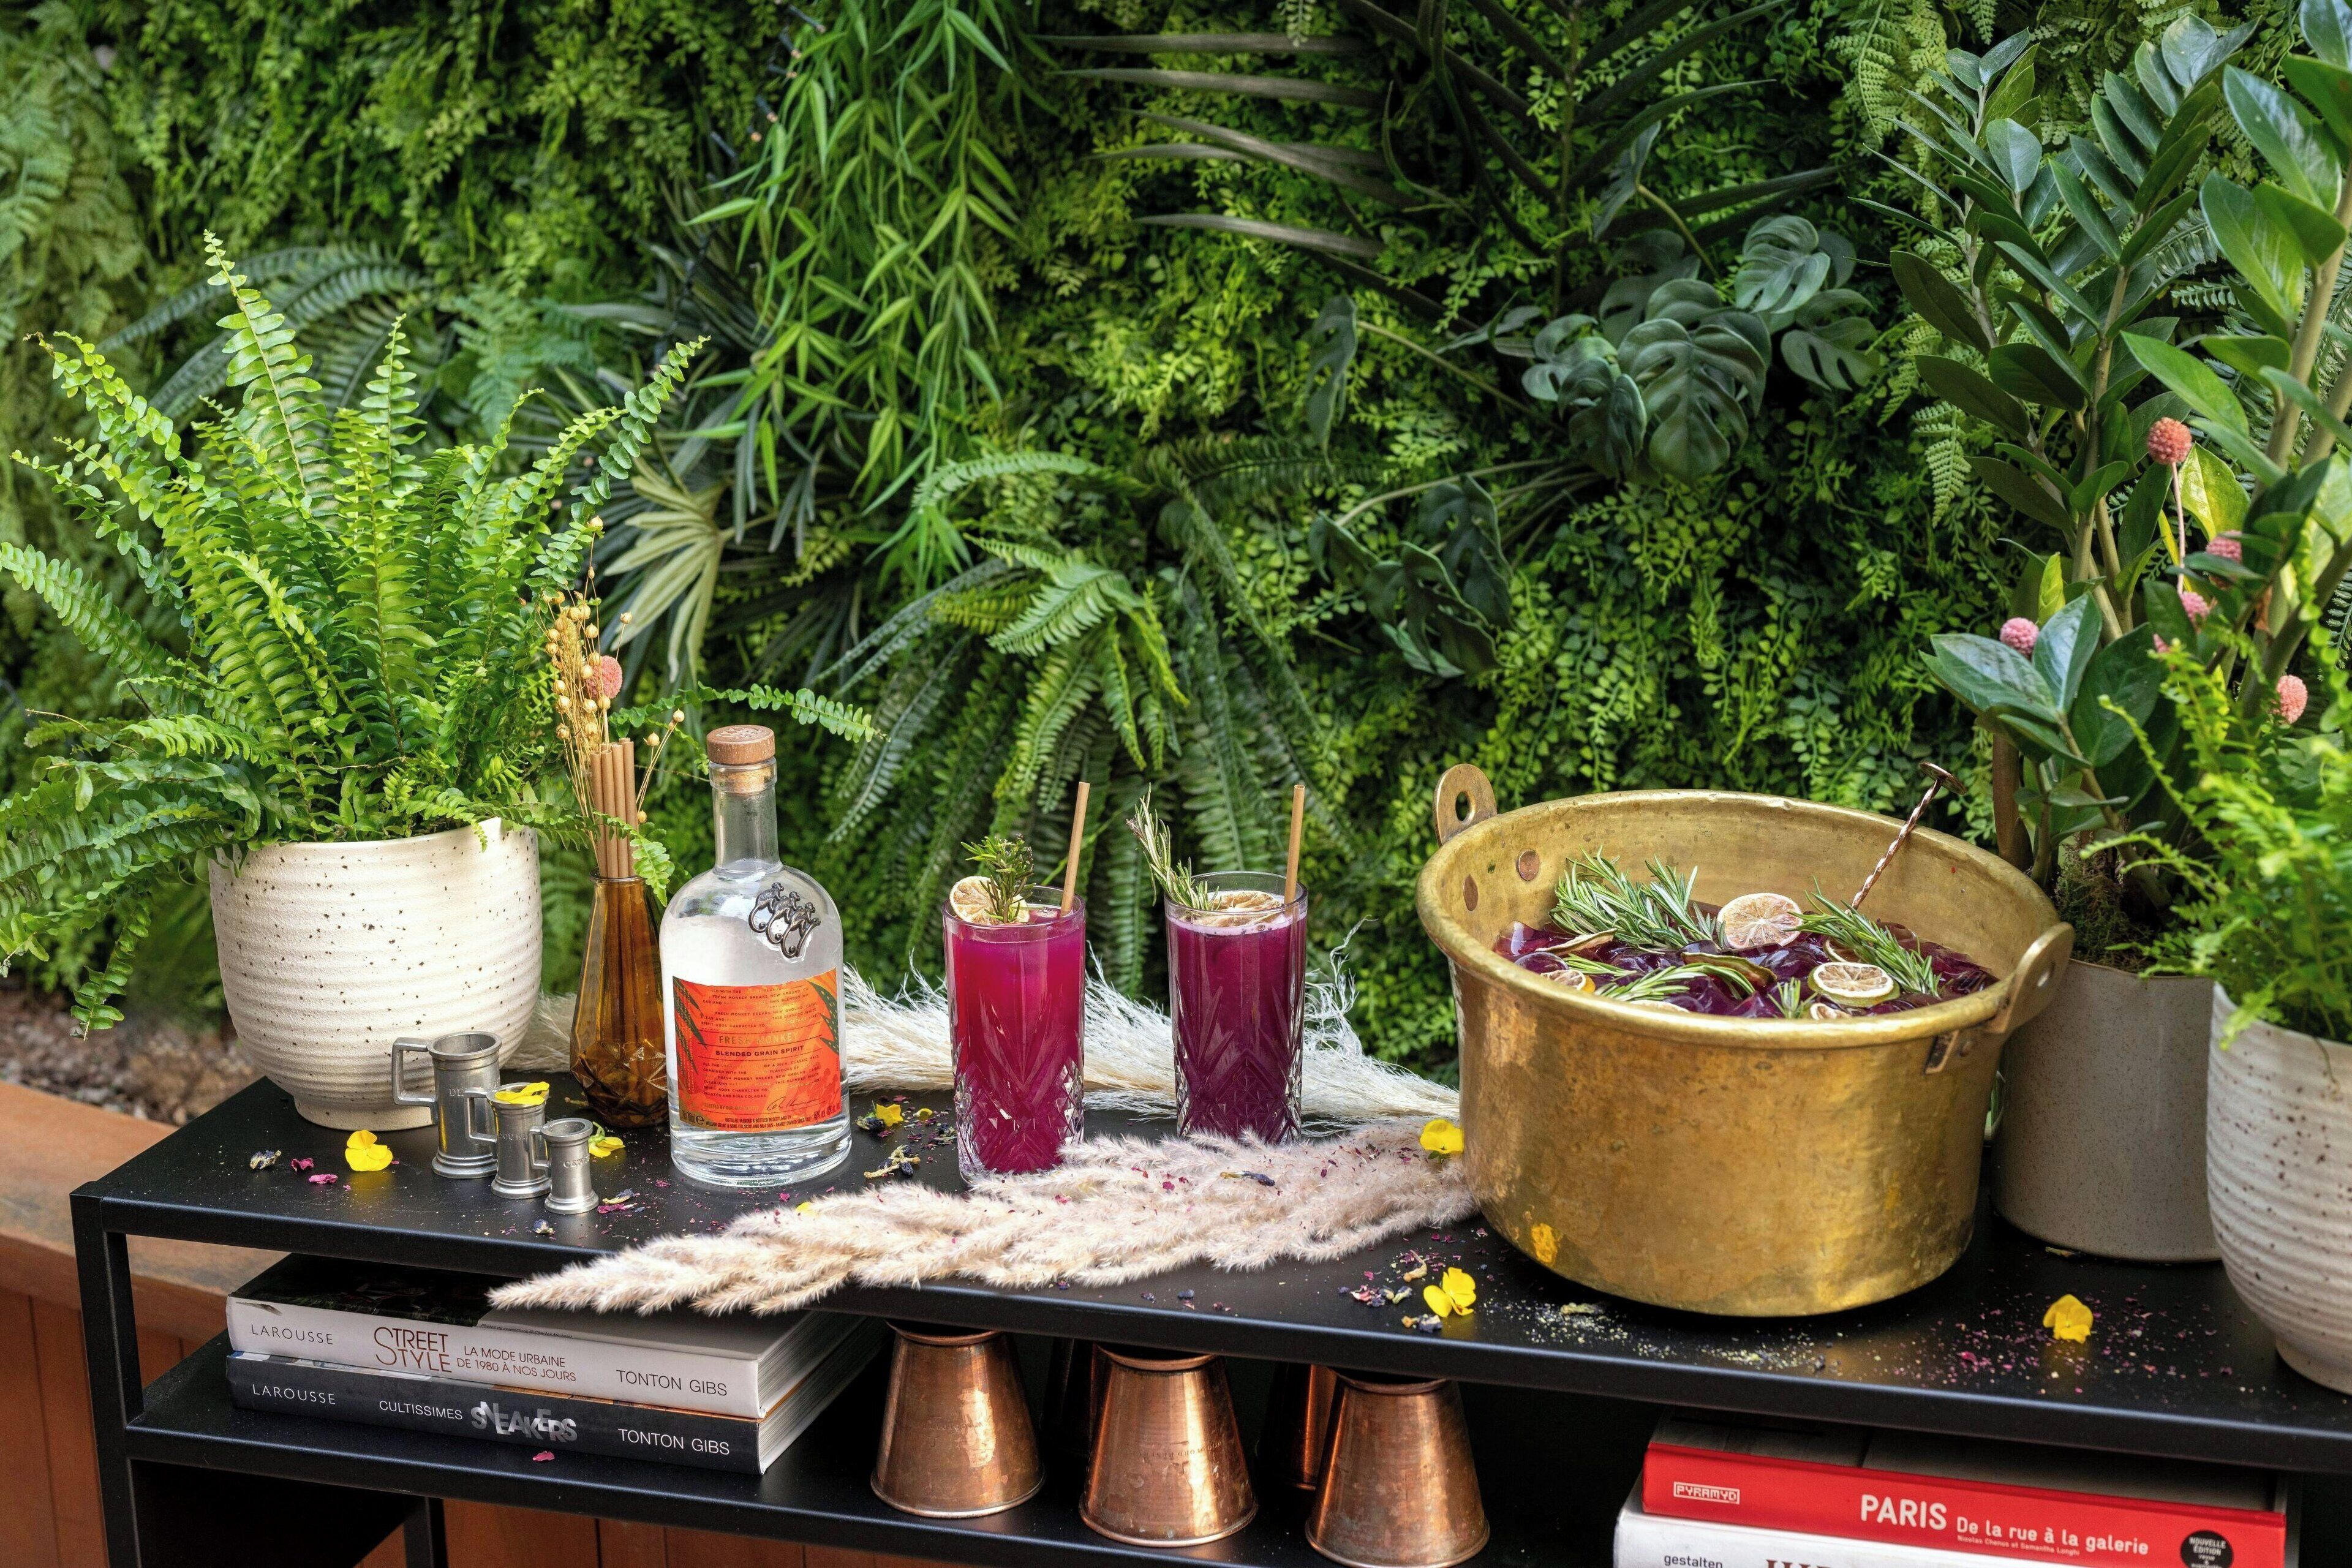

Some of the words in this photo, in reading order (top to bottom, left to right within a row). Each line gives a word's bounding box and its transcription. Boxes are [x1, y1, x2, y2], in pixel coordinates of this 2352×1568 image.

[719, 1035, 750, 1044] FRESH
[756, 1032, 799, 1044] MONKEY
[781, 1045, 804, 1054] SPIRIT
[251, 1324, 334, 1345] LAROUSSE
[374, 1327, 448, 1354] STREET
[464, 1346, 478, 1357] LA
[481, 1347, 515, 1361] MODE
[519, 1352, 566, 1368] URBAINE
[457, 1357, 472, 1368] DE
[475, 1359, 499, 1371] 1980
[502, 1359, 511, 1373] À
[513, 1365, 538, 1377] NOS
[540, 1368, 576, 1382] JOURS
[616, 1370, 682, 1390] TONTON
[690, 1379, 728, 1396] GIBS
[252, 1384, 336, 1405] LAROUSSE
[379, 1400, 463, 1420] CULTISSIMES
[470, 1401, 578, 1442] SNEAKERS
[617, 1428, 684, 1449] TONTON
[692, 1438, 729, 1455] GIBS
[1676, 1484, 1738, 1502] PYRAMYD
[1860, 1494, 1948, 1531] PARIS
[1957, 1516, 1979, 1534] De
[1985, 1520, 2002, 1537] la
[2009, 1526, 2038, 1542] rue
[2044, 1526, 2055, 1544] à
[2062, 1529, 2079, 1547] la
[2086, 1535, 2149, 1556] galerie
[1957, 1535, 1983, 1544] Nicolas
[2188, 1536, 2226, 1550] NOUVELLE
[1664, 1554, 1722, 1568] gestalten
